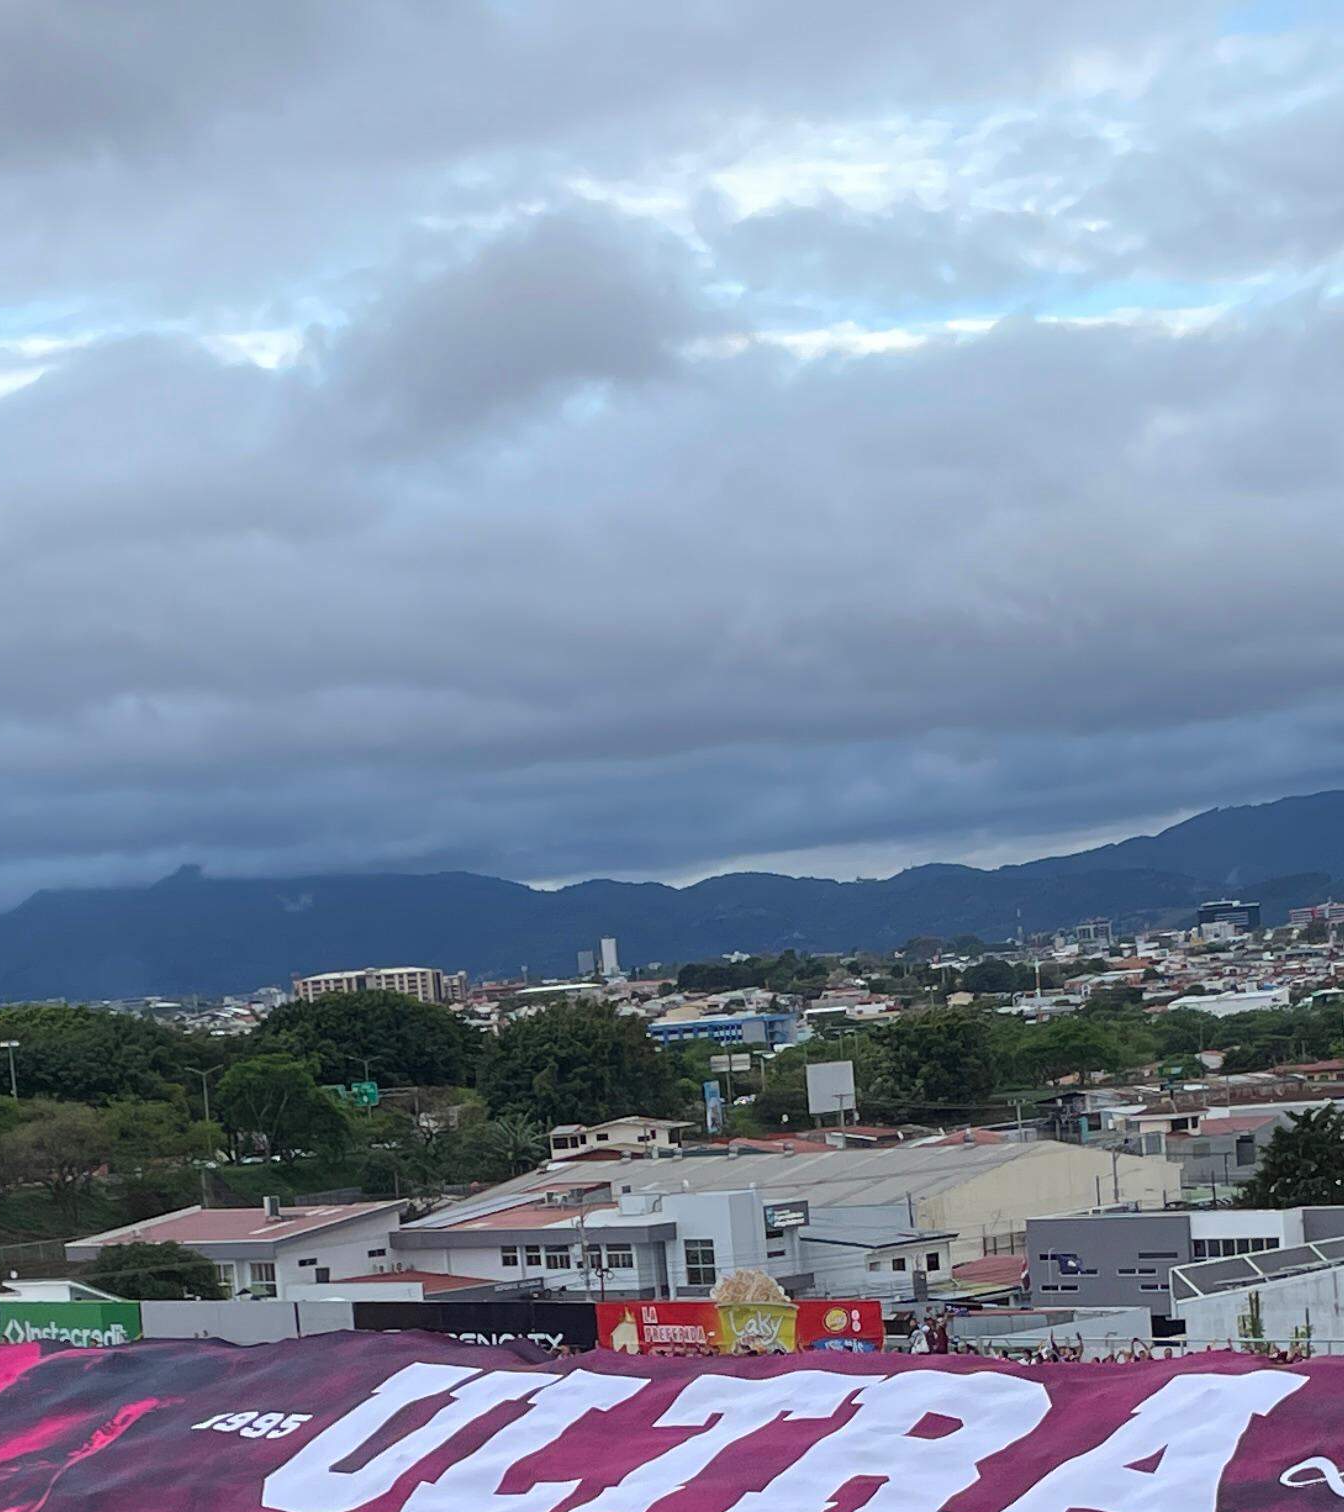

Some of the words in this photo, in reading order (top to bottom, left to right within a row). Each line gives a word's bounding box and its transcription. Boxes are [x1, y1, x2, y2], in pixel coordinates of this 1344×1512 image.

[641, 1306, 657, 1323] LA
[24, 1320, 128, 1348] Instacredit
[189, 1411, 311, 1440] 1995
